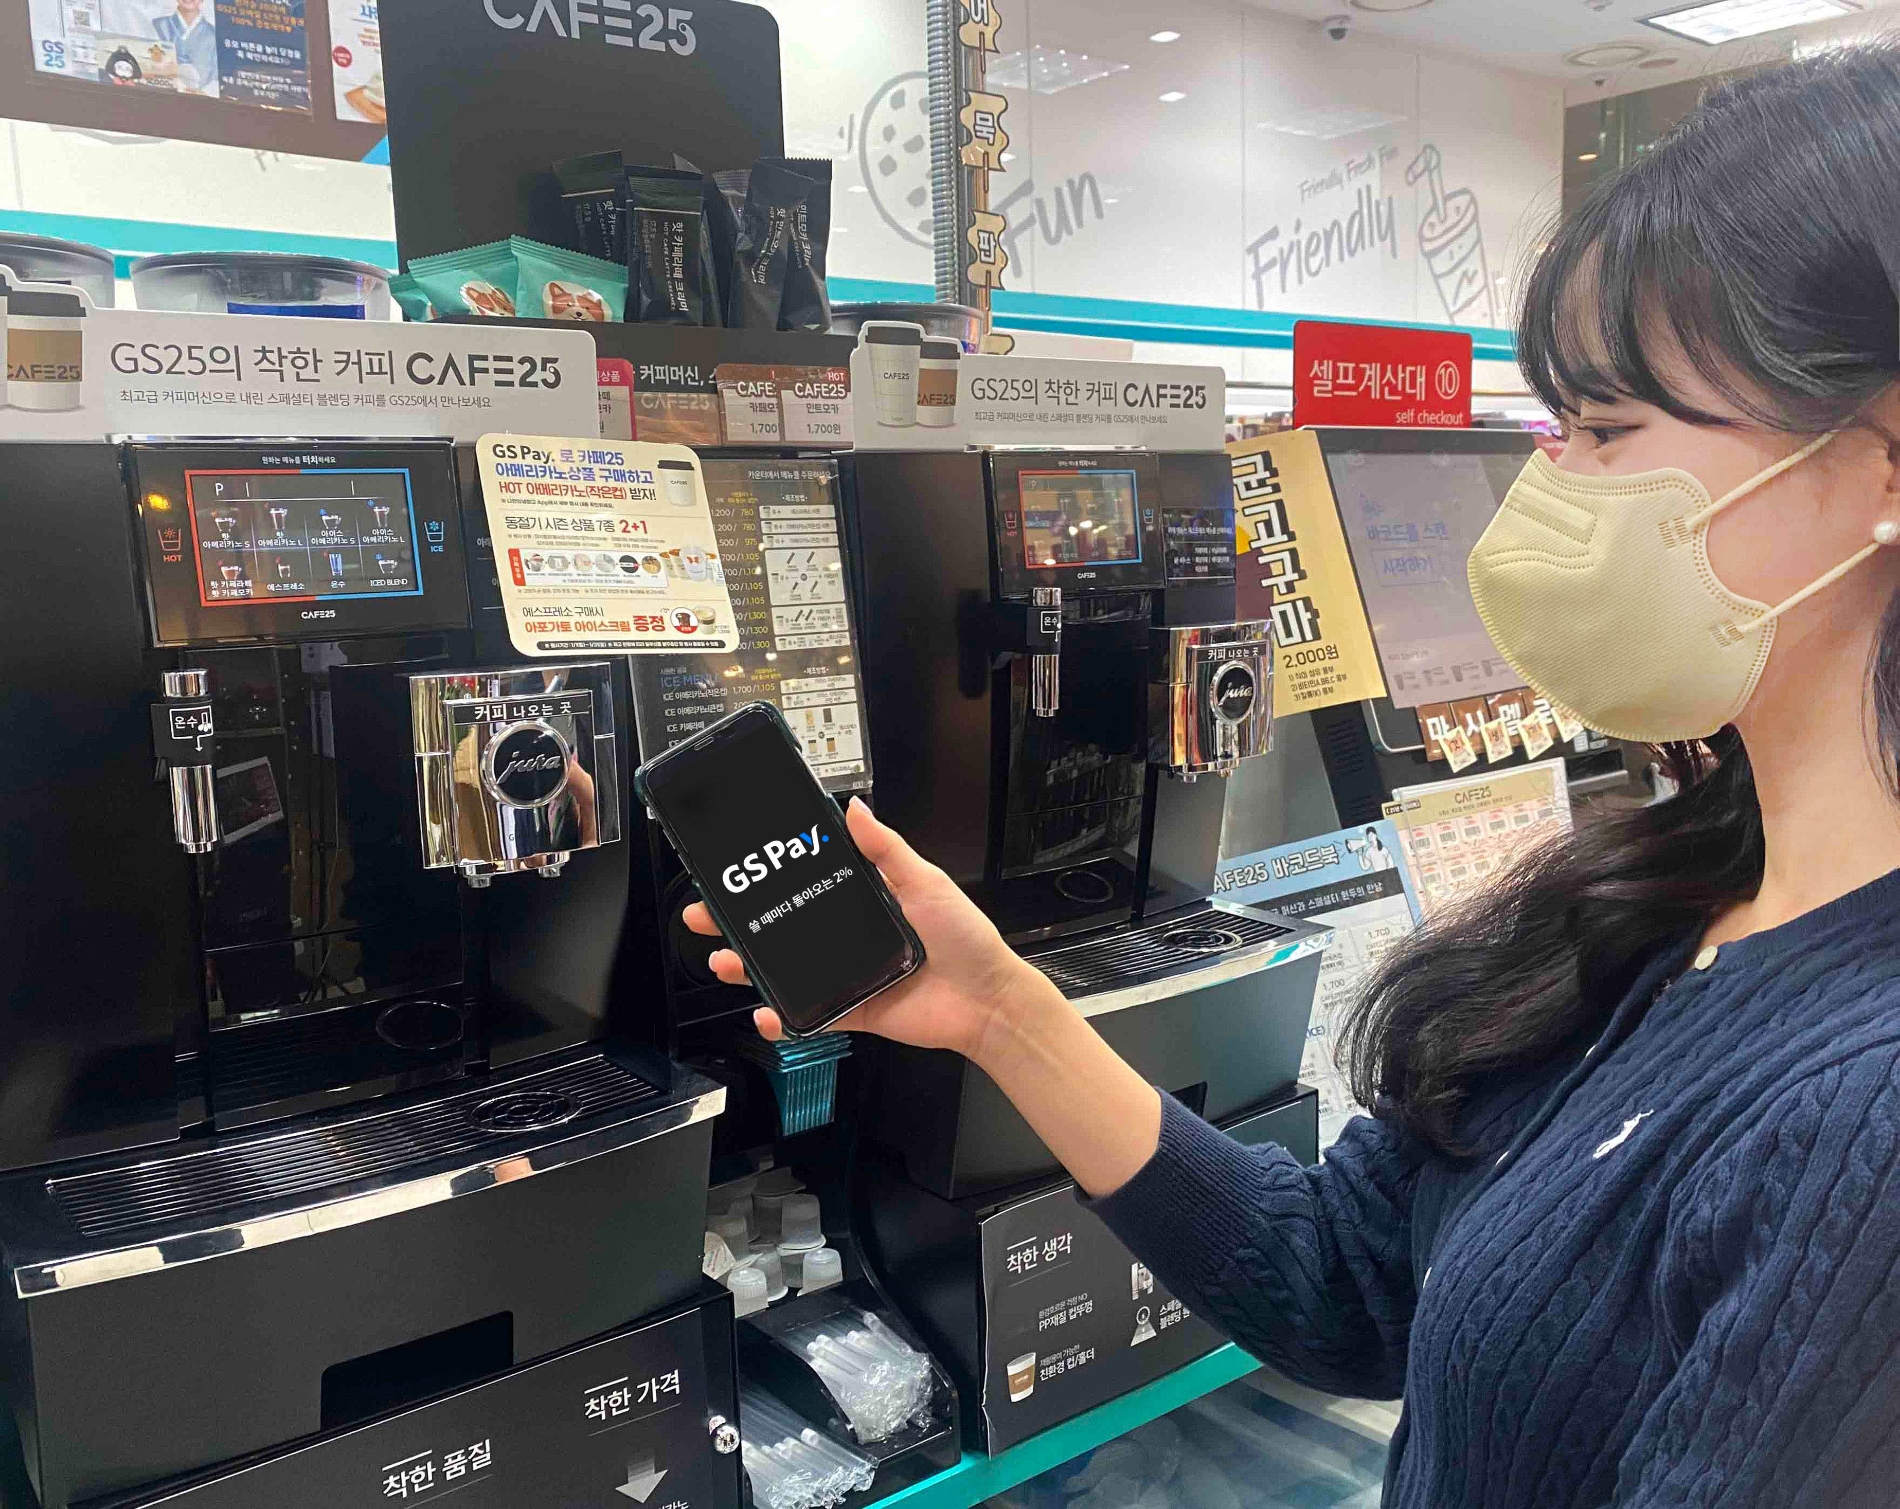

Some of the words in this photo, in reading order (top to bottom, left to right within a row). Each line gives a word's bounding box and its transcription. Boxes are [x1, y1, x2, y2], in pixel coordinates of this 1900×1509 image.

[483, 0, 697, 56] CAFE25
[672, 222, 684, 232] 핫
[992, 171, 1104, 279] Fun
[671, 235, 684, 279] 카페라떼
[1246, 184, 1398, 310] Friendly
[674, 280, 689, 311] 크리머
[7, 364, 81, 381] CAFE25
[110, 342, 242, 381] GS25의
[253, 345, 323, 382] 착한
[334, 350, 395, 385] 커피
[406, 352, 562, 389] CAFE25
[640, 364, 704, 386] 커피머신,
[827, 372, 845, 381] HOT
[1309, 360, 1427, 401] 셀프계산대
[737, 381, 777, 396] CAFE
[794, 382, 846, 397] CAFE25
[970, 378, 1038, 405] GS25의
[1044, 378, 1081, 406] 착한
[1085, 380, 1117, 407] 커피
[1123, 383, 1207, 409] CAFE25
[120, 390, 159, 404] 최고급
[162, 390, 237, 404] 커피머신으로
[239, 391, 264, 405] 내린
[267, 391, 313, 405] 스페셜티
[316, 393, 351, 406] 블렌딩
[353, 393, 387, 407] 커피를
[389, 395, 438, 407] GS25에서
[440, 395, 492, 408] 만나보세요
[1395, 408, 1414, 424] self
[1418, 409, 1464, 426] checkout
[492, 444, 518, 459] GS
[560, 448, 575, 463] 로
[577, 450, 624, 466] 카페25
[495, 463, 596, 482] 아메리카노상품
[599, 468, 655, 484] 구매하고
[499, 481, 523, 493] HOT
[526, 482, 627, 500] 아메리카노(작은컵)
[629, 487, 657, 501] 받자!
[505, 516, 543, 530] 동절기
[545, 517, 569, 532] 시즌
[571, 518, 596, 532] 상품
[597, 520, 615, 533] 7종
[619, 519, 648, 534] 2+1
[163, 554, 182, 562] HOT
[1231, 450, 1322, 648] 군고구마
[301, 610, 336, 619] CAFE25
[522, 607, 573, 618] 에스프레소
[574, 606, 604, 618] 구매시
[1044, 616, 1058, 626] 온수
[525, 621, 573, 634] 아포가토
[575, 620, 631, 633] 아이스크림
[633, 615, 667, 632] 증정
[1208, 648, 1226, 660] 커피
[1228, 649, 1250, 659] 나오는
[1283, 644, 1339, 668] 2.000원
[661, 676, 681, 688] ICE
[663, 693, 674, 701] ICE
[475, 703, 507, 721] 커피
[513, 704, 554, 718] 나오는
[560, 701, 572, 714] 곳
[665, 708, 677, 716] ICE
[174, 715, 197, 728] 온수
[667, 724, 678, 732] ICE
[496, 750, 562, 785] jura
[1454, 786, 1493, 804] CAFE25
[1271, 844, 1339, 879] 바코드북
[722, 852, 768, 894] GS
[748, 919, 762, 934] 쓸
[760, 901, 793, 925] 때마다
[792, 878, 835, 908] 돌아오는
[833, 866, 853, 883] 2%
[1007, 1247, 1039, 1274] 착한
[1043, 1232, 1073, 1262] 생각
[1078, 1292, 1088, 1302] NO
[1039, 1310, 1067, 1331] PP재질
[1068, 1300, 1093, 1320] 컵뚜껑
[1040, 1360, 1065, 1381] 친환경
[1067, 1347, 1095, 1370] 컵/홀더
[583, 1389, 632, 1422] 착한
[636, 1368, 681, 1406] 가격
[382, 1461, 436, 1500] 착한
[441, 1438, 492, 1479] 품질
